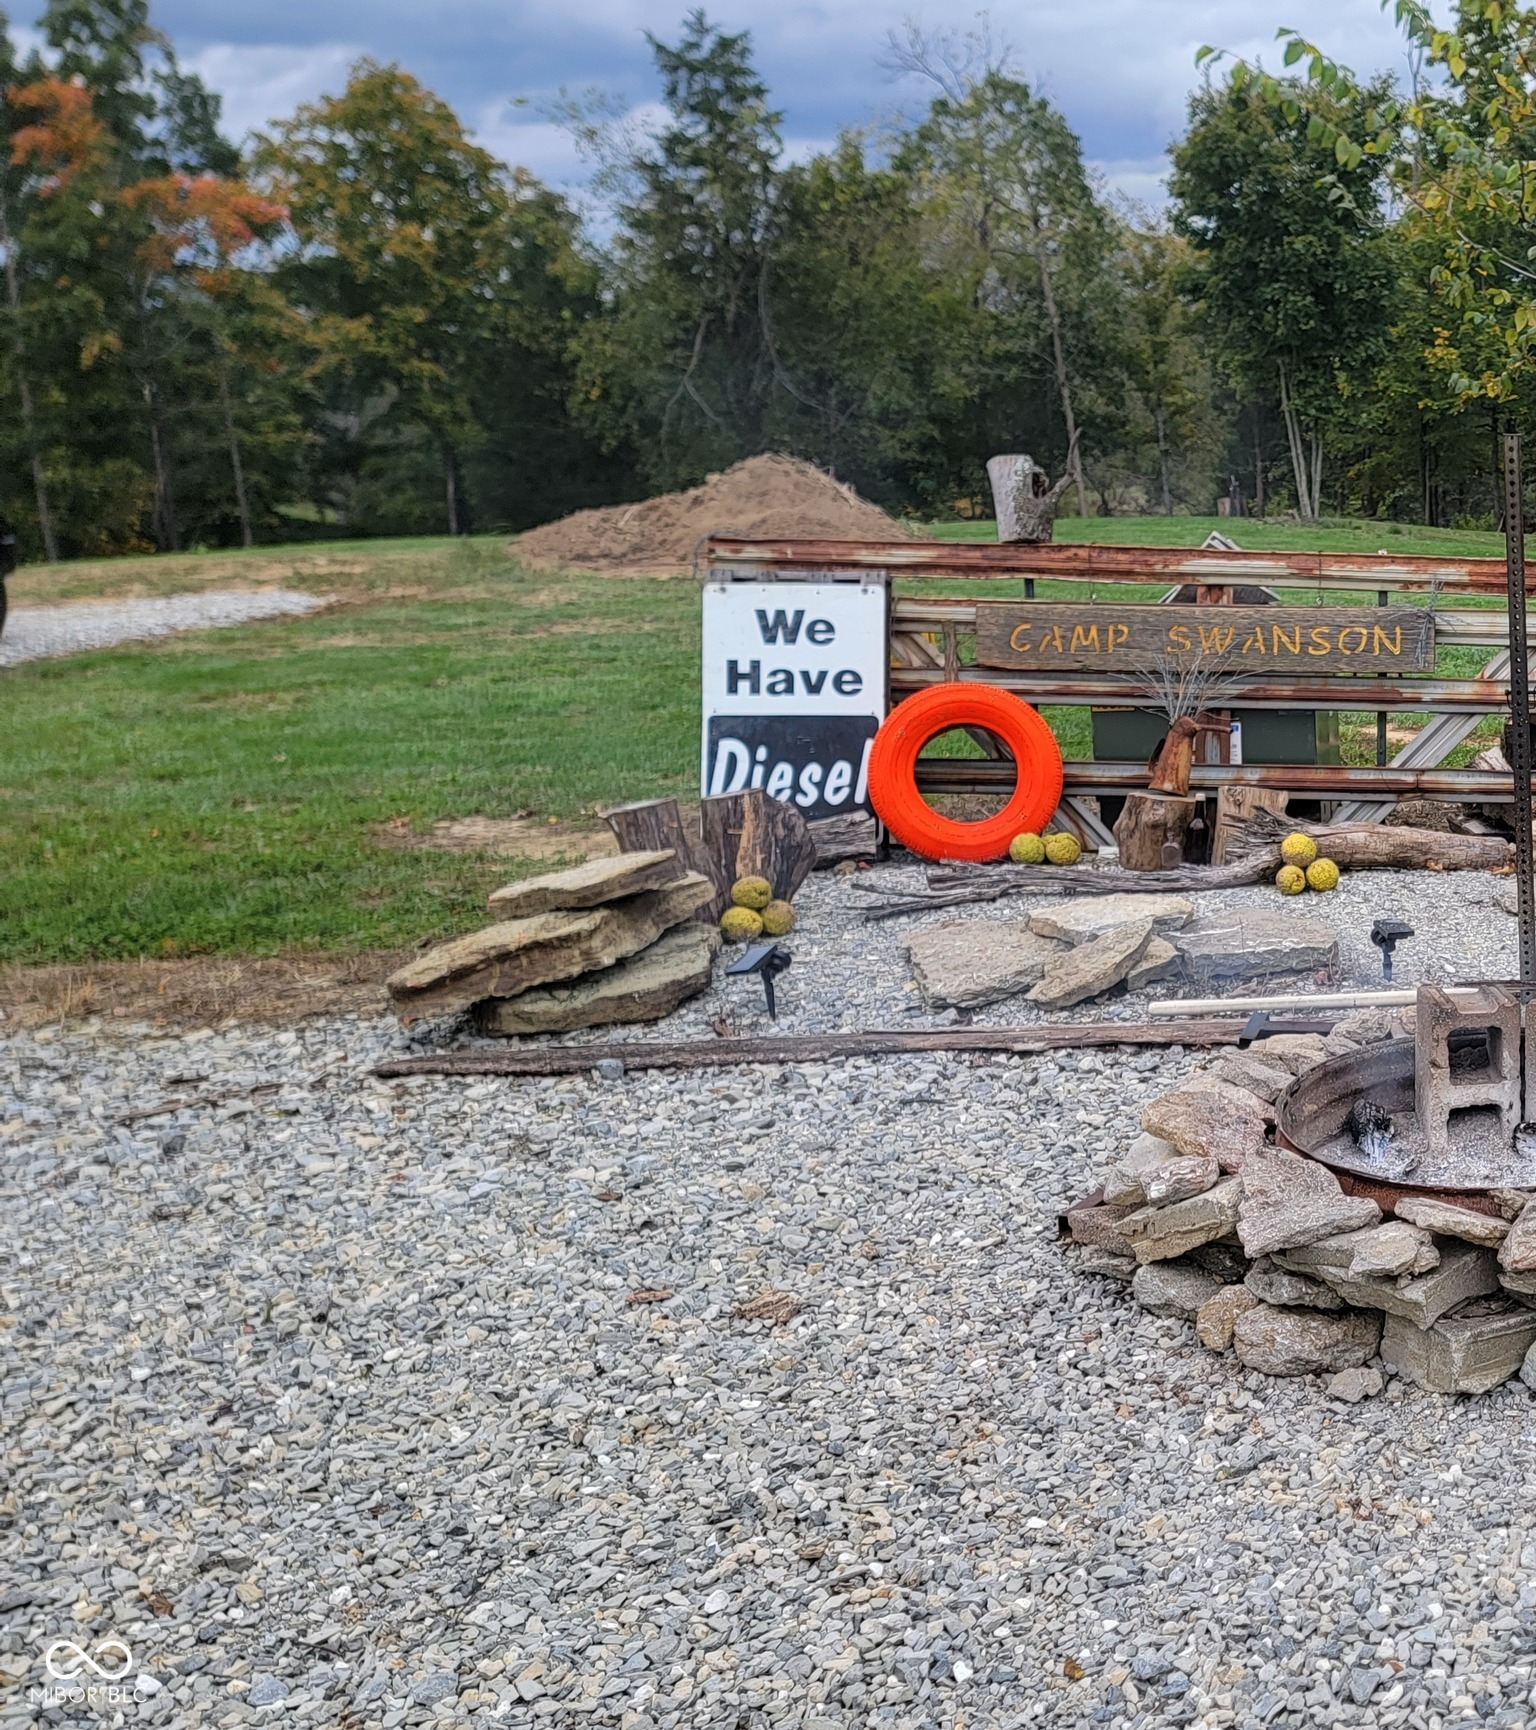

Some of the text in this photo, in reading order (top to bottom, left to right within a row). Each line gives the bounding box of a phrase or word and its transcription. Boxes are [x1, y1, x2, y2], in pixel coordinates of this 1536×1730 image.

[754, 609, 836, 646] We
[1009, 622, 1402, 656] CAMP SWANSON
[726, 660, 863, 697] Have
[709, 737, 874, 808] Diesel
